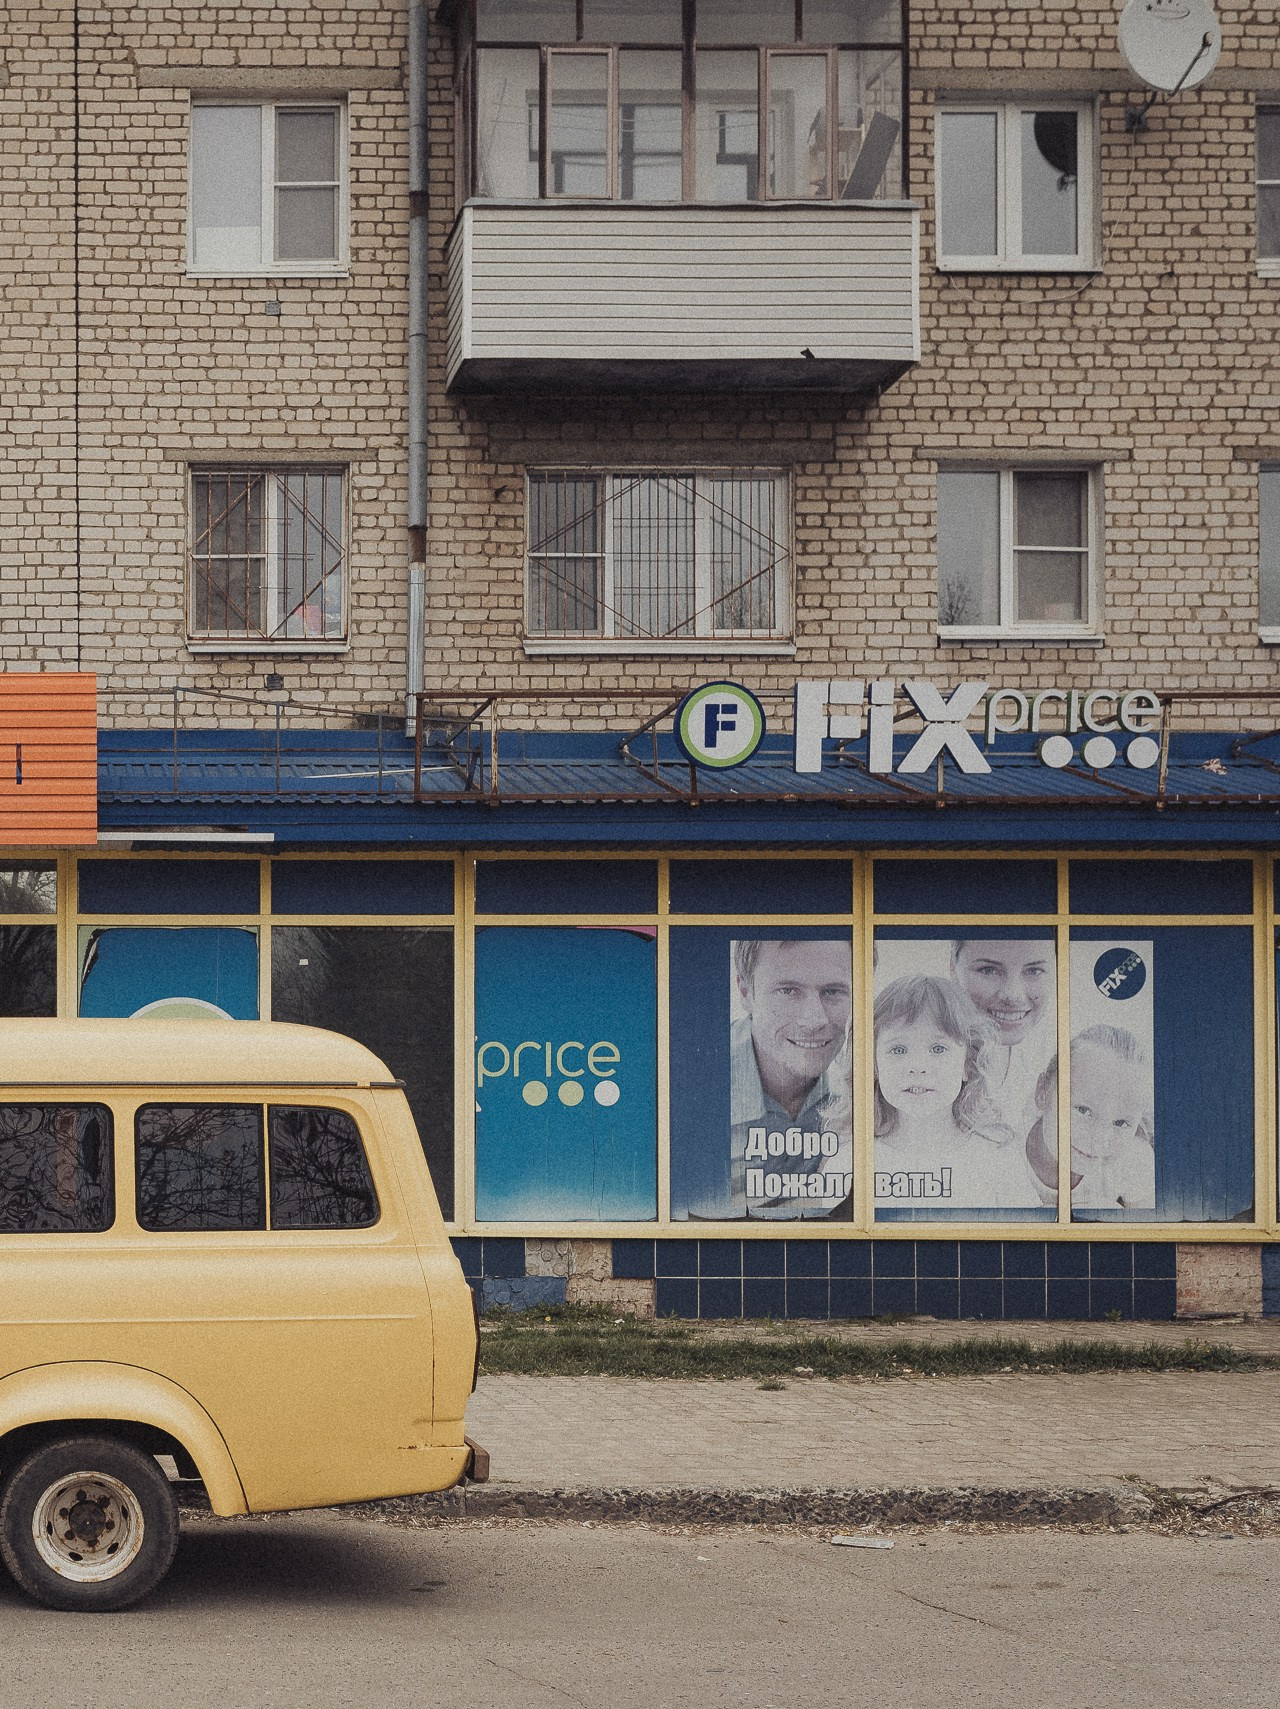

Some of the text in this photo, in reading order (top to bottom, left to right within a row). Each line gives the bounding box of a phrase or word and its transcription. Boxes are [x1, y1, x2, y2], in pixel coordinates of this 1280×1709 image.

[705, 703, 738, 748] F
[987, 688, 1161, 745] price
[477, 1041, 620, 1088] price
[744, 1127, 838, 1160] Добро
